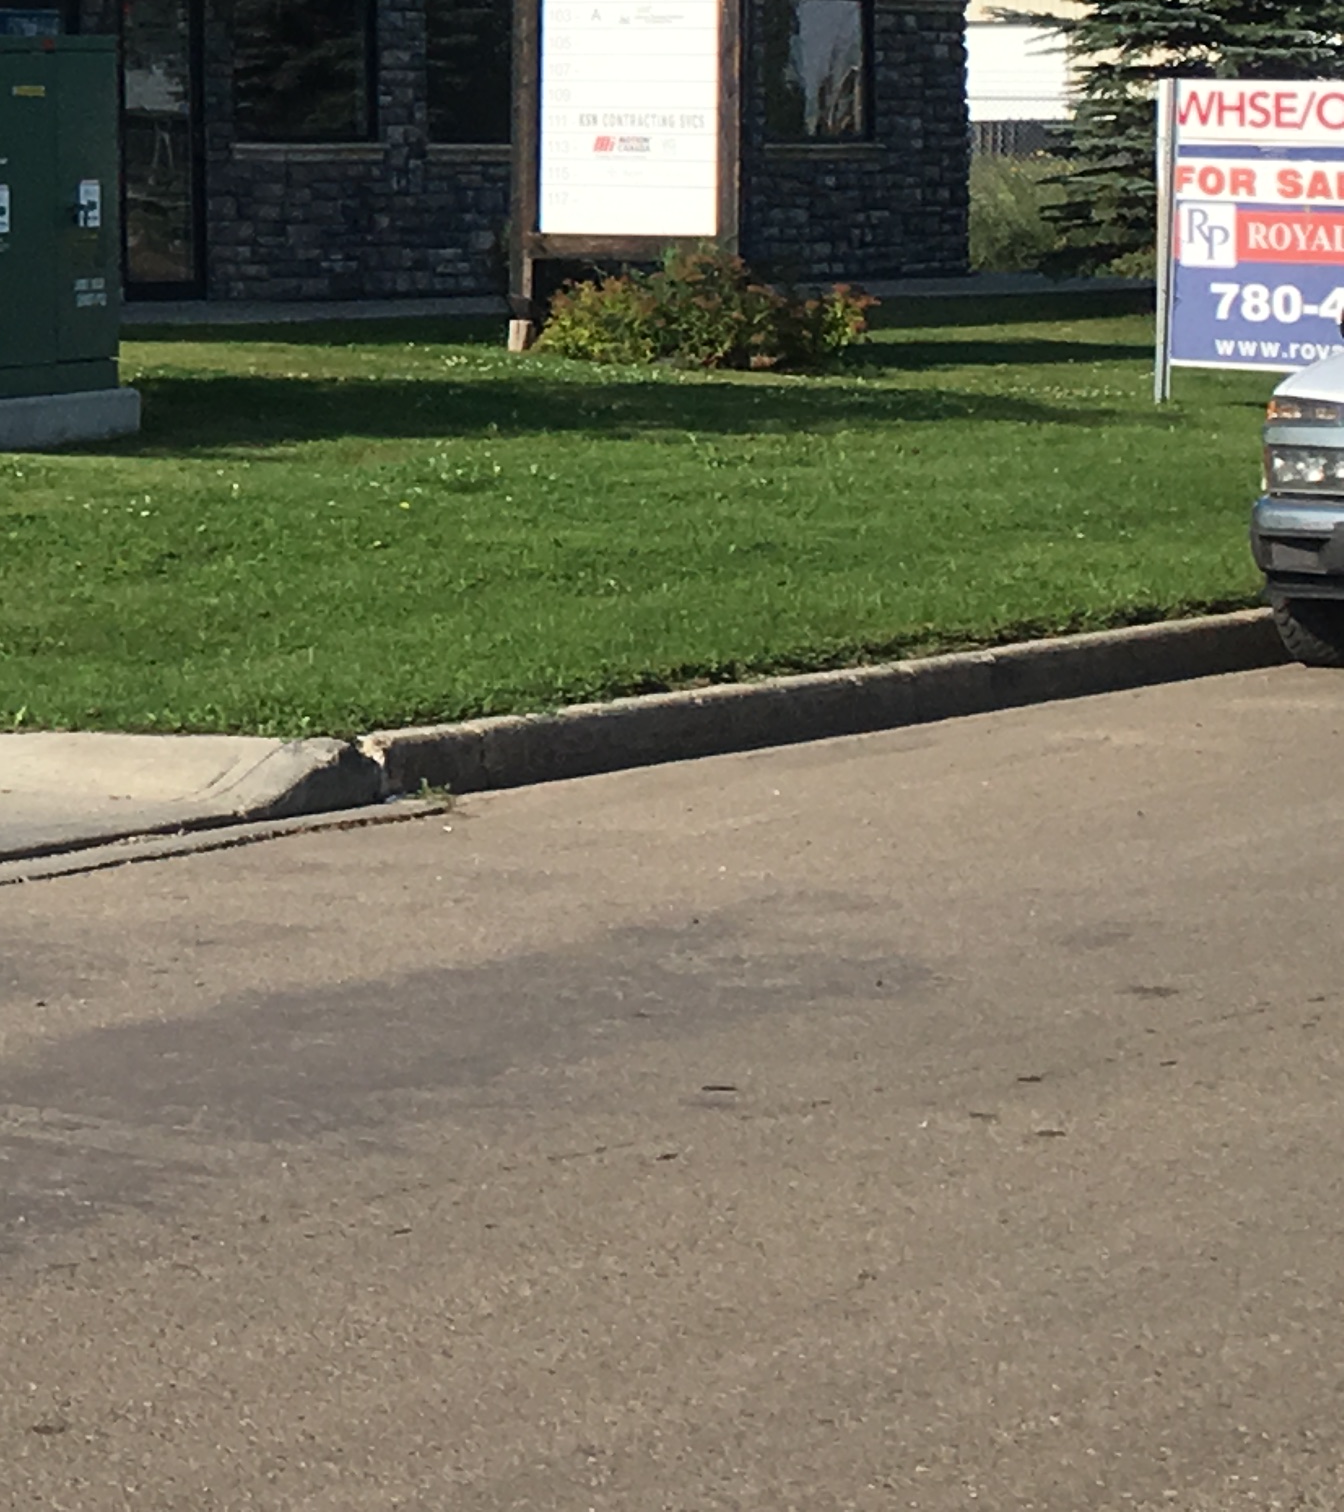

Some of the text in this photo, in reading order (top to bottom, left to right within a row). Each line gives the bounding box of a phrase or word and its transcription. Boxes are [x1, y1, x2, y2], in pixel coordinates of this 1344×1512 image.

[602, 113, 676, 128] CONTRACTING
[680, 114, 705, 129] SVCS
[1176, 165, 1256, 196] FOR
[1210, 282, 1344, 326] 780-4
